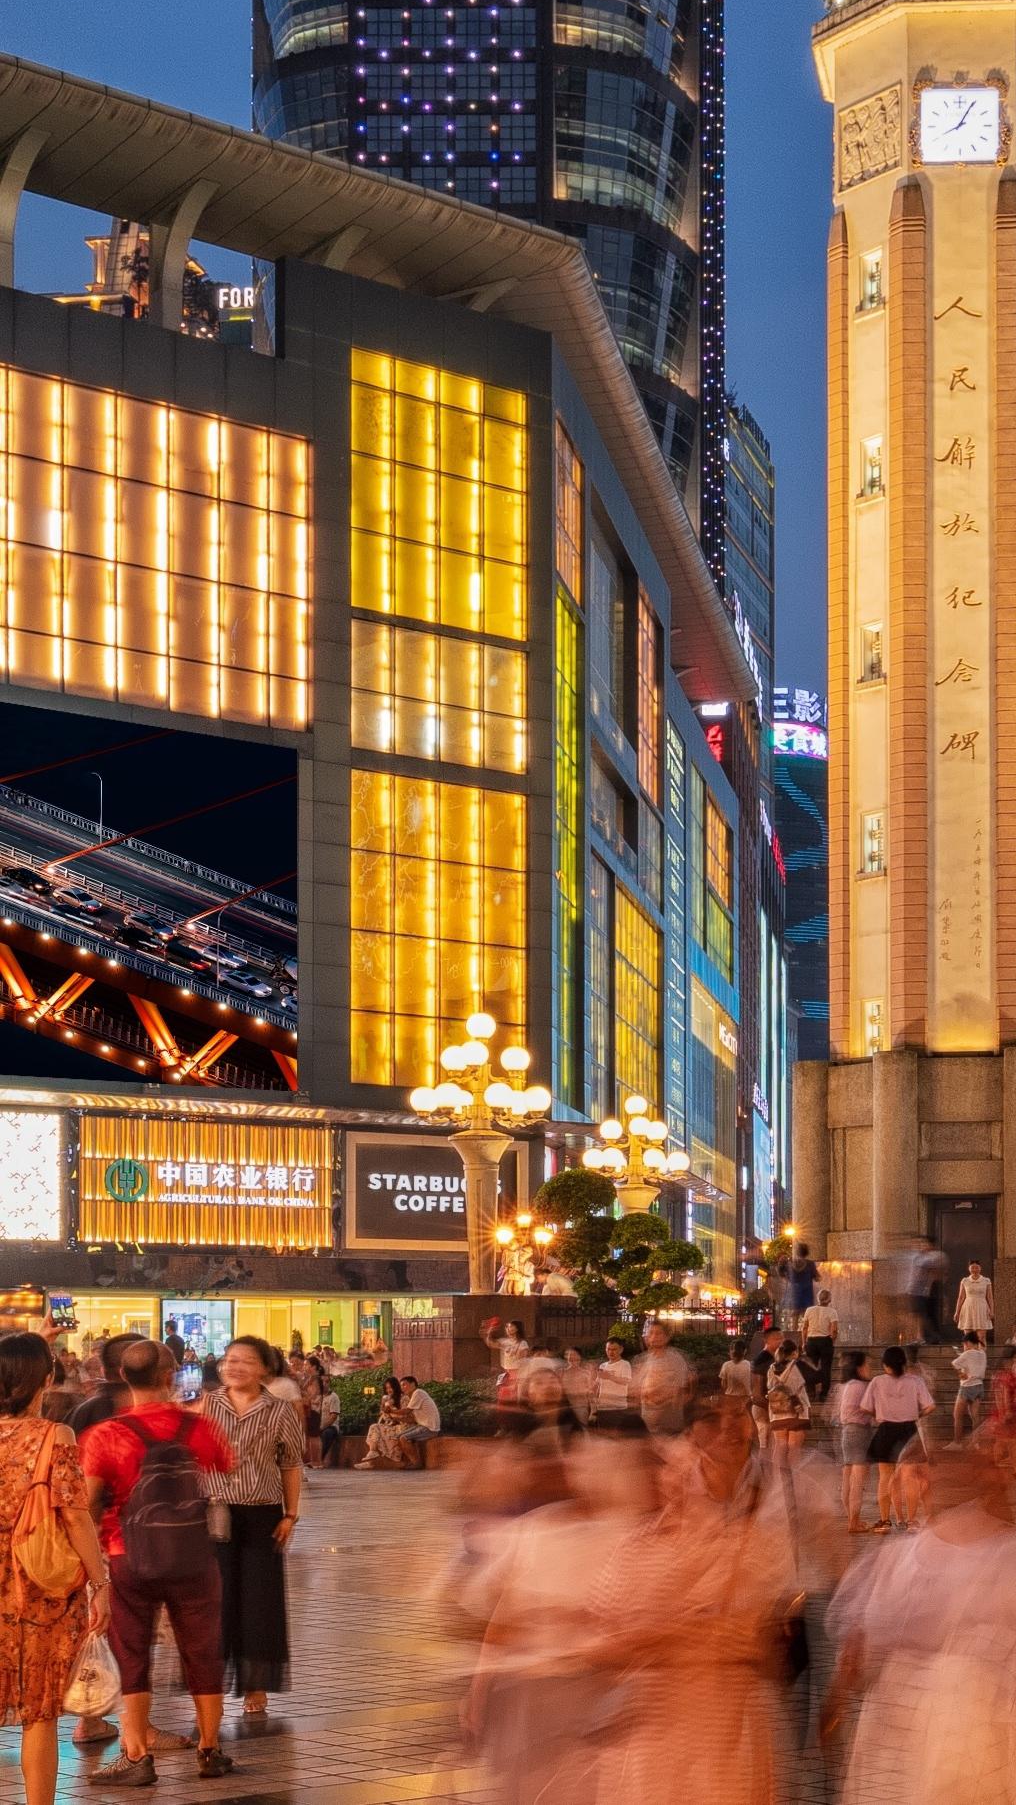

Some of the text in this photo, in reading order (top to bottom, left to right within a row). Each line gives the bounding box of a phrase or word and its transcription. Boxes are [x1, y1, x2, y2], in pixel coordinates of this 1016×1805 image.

[157, 1161, 316, 1192] 中国农业银行
[158, 1193, 315, 1207] AGRICULTURAL BANK OF CHINA
[394, 1194, 465, 1213] COFFE
